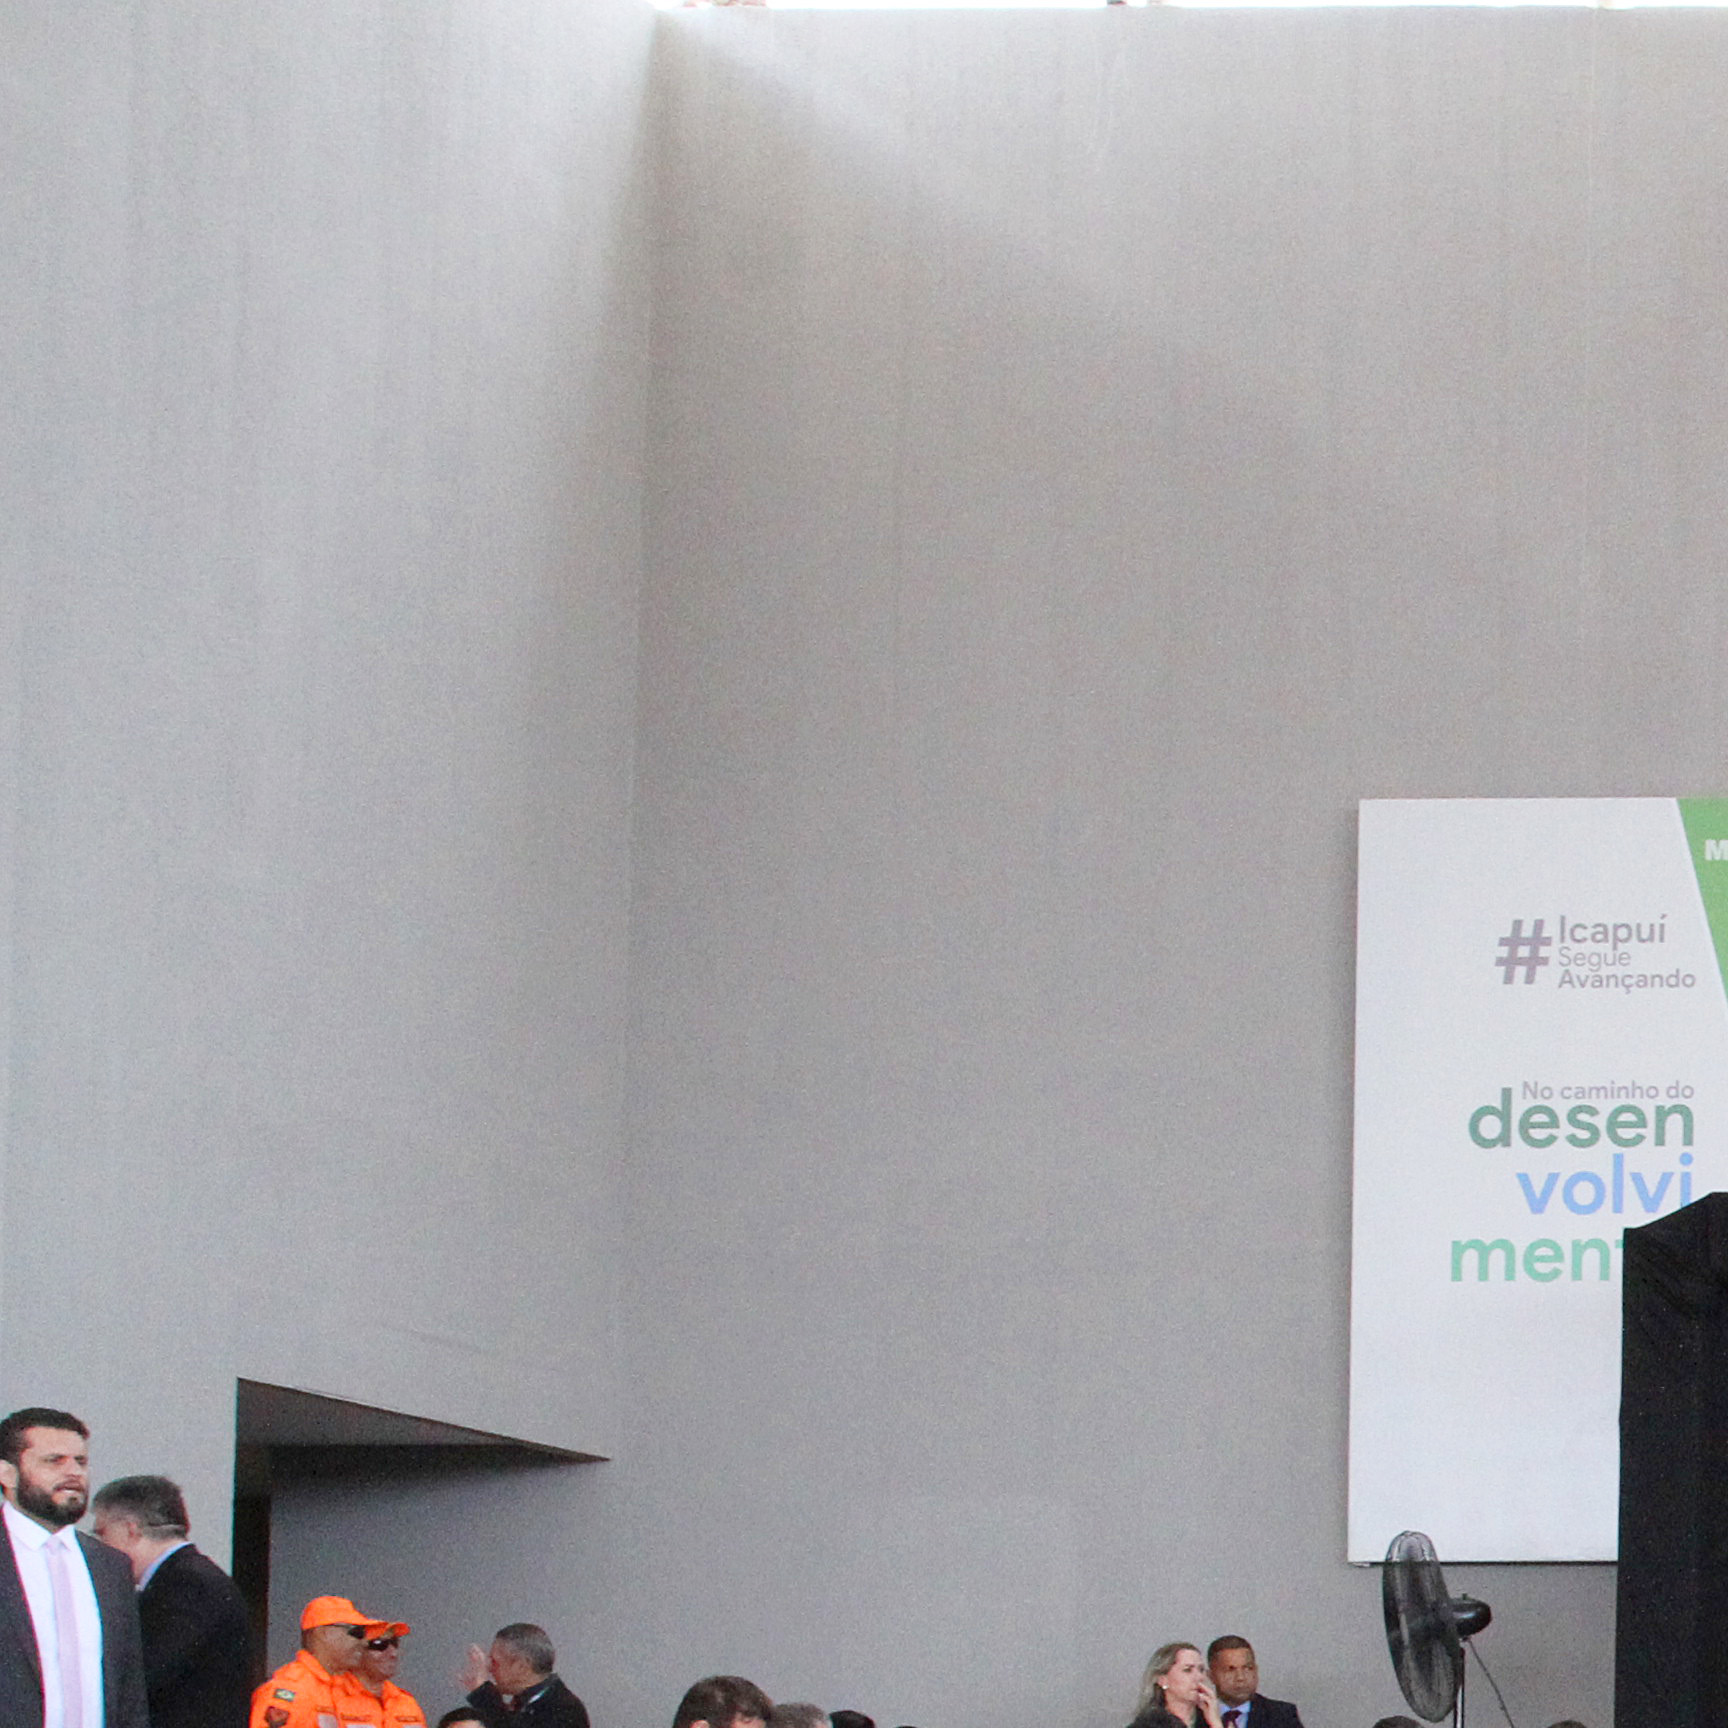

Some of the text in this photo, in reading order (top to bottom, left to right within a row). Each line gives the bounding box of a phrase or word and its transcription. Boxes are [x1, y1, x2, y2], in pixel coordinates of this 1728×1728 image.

[1559, 913, 1668, 948] Icapuí
[1558, 946, 1632, 971] Segue
[1557, 967, 1697, 994] Avançando
[1521, 1080, 1696, 1100] No caminho do
[1468, 1086, 1696, 1149] desen
[1516, 1152, 1694, 1215] volvi
[1450, 1236, 1623, 1283] men
